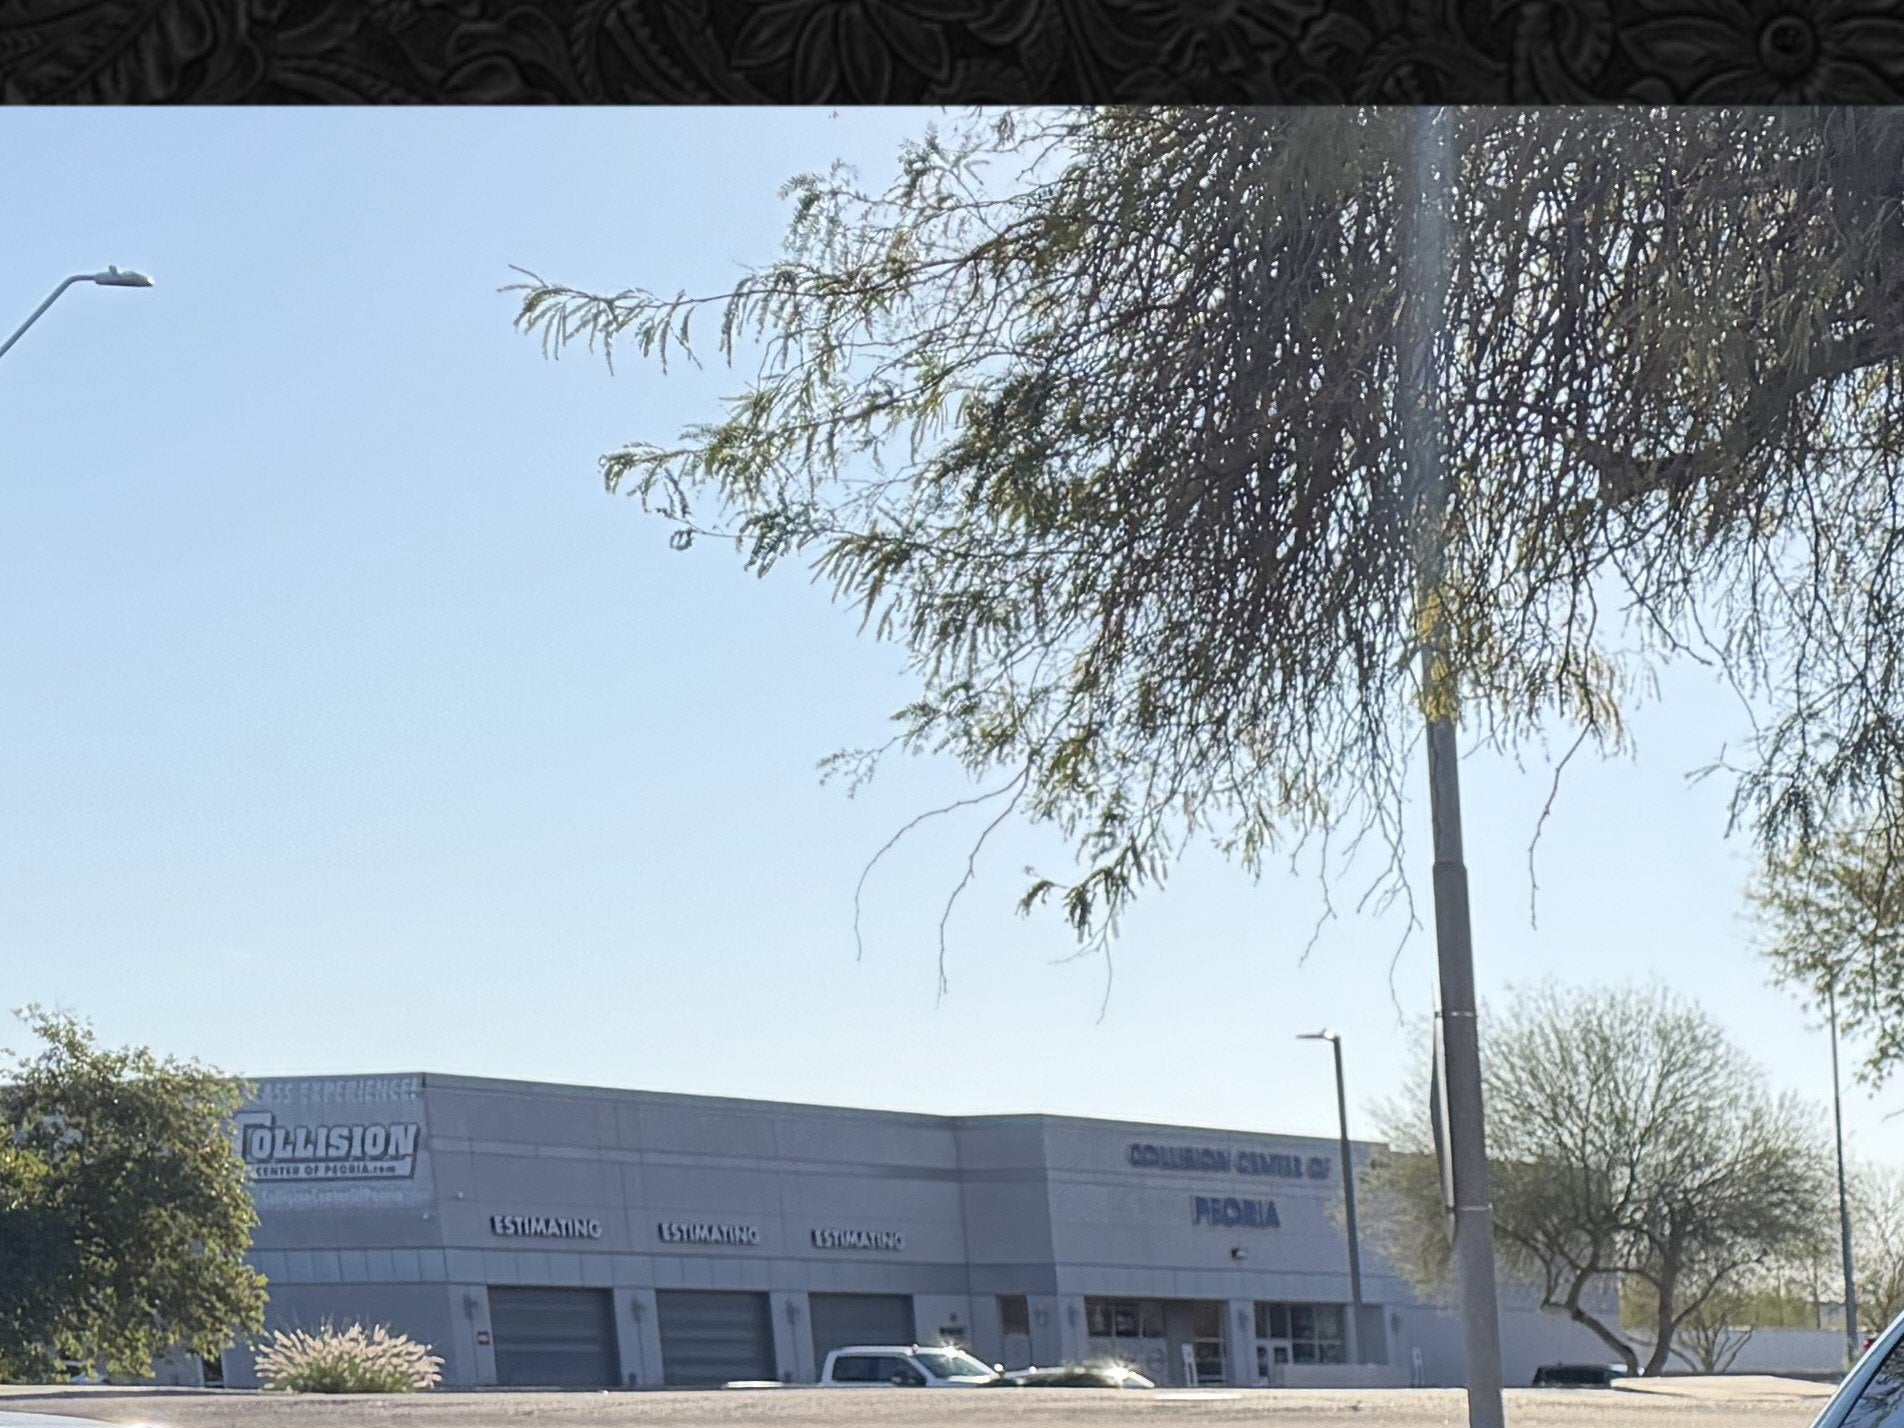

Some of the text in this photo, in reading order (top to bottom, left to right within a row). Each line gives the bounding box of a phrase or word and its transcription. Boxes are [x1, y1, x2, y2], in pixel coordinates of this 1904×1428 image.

[234, 1112, 418, 1160] COLLISION
[304, 1163, 320, 1176] OF
[1192, 1196, 1281, 1229] PEORIA
[491, 1215, 602, 1239] ESTIMATING
[659, 1222, 761, 1246] ESTIMATING
[812, 1229, 906, 1251] ESTIMATING
